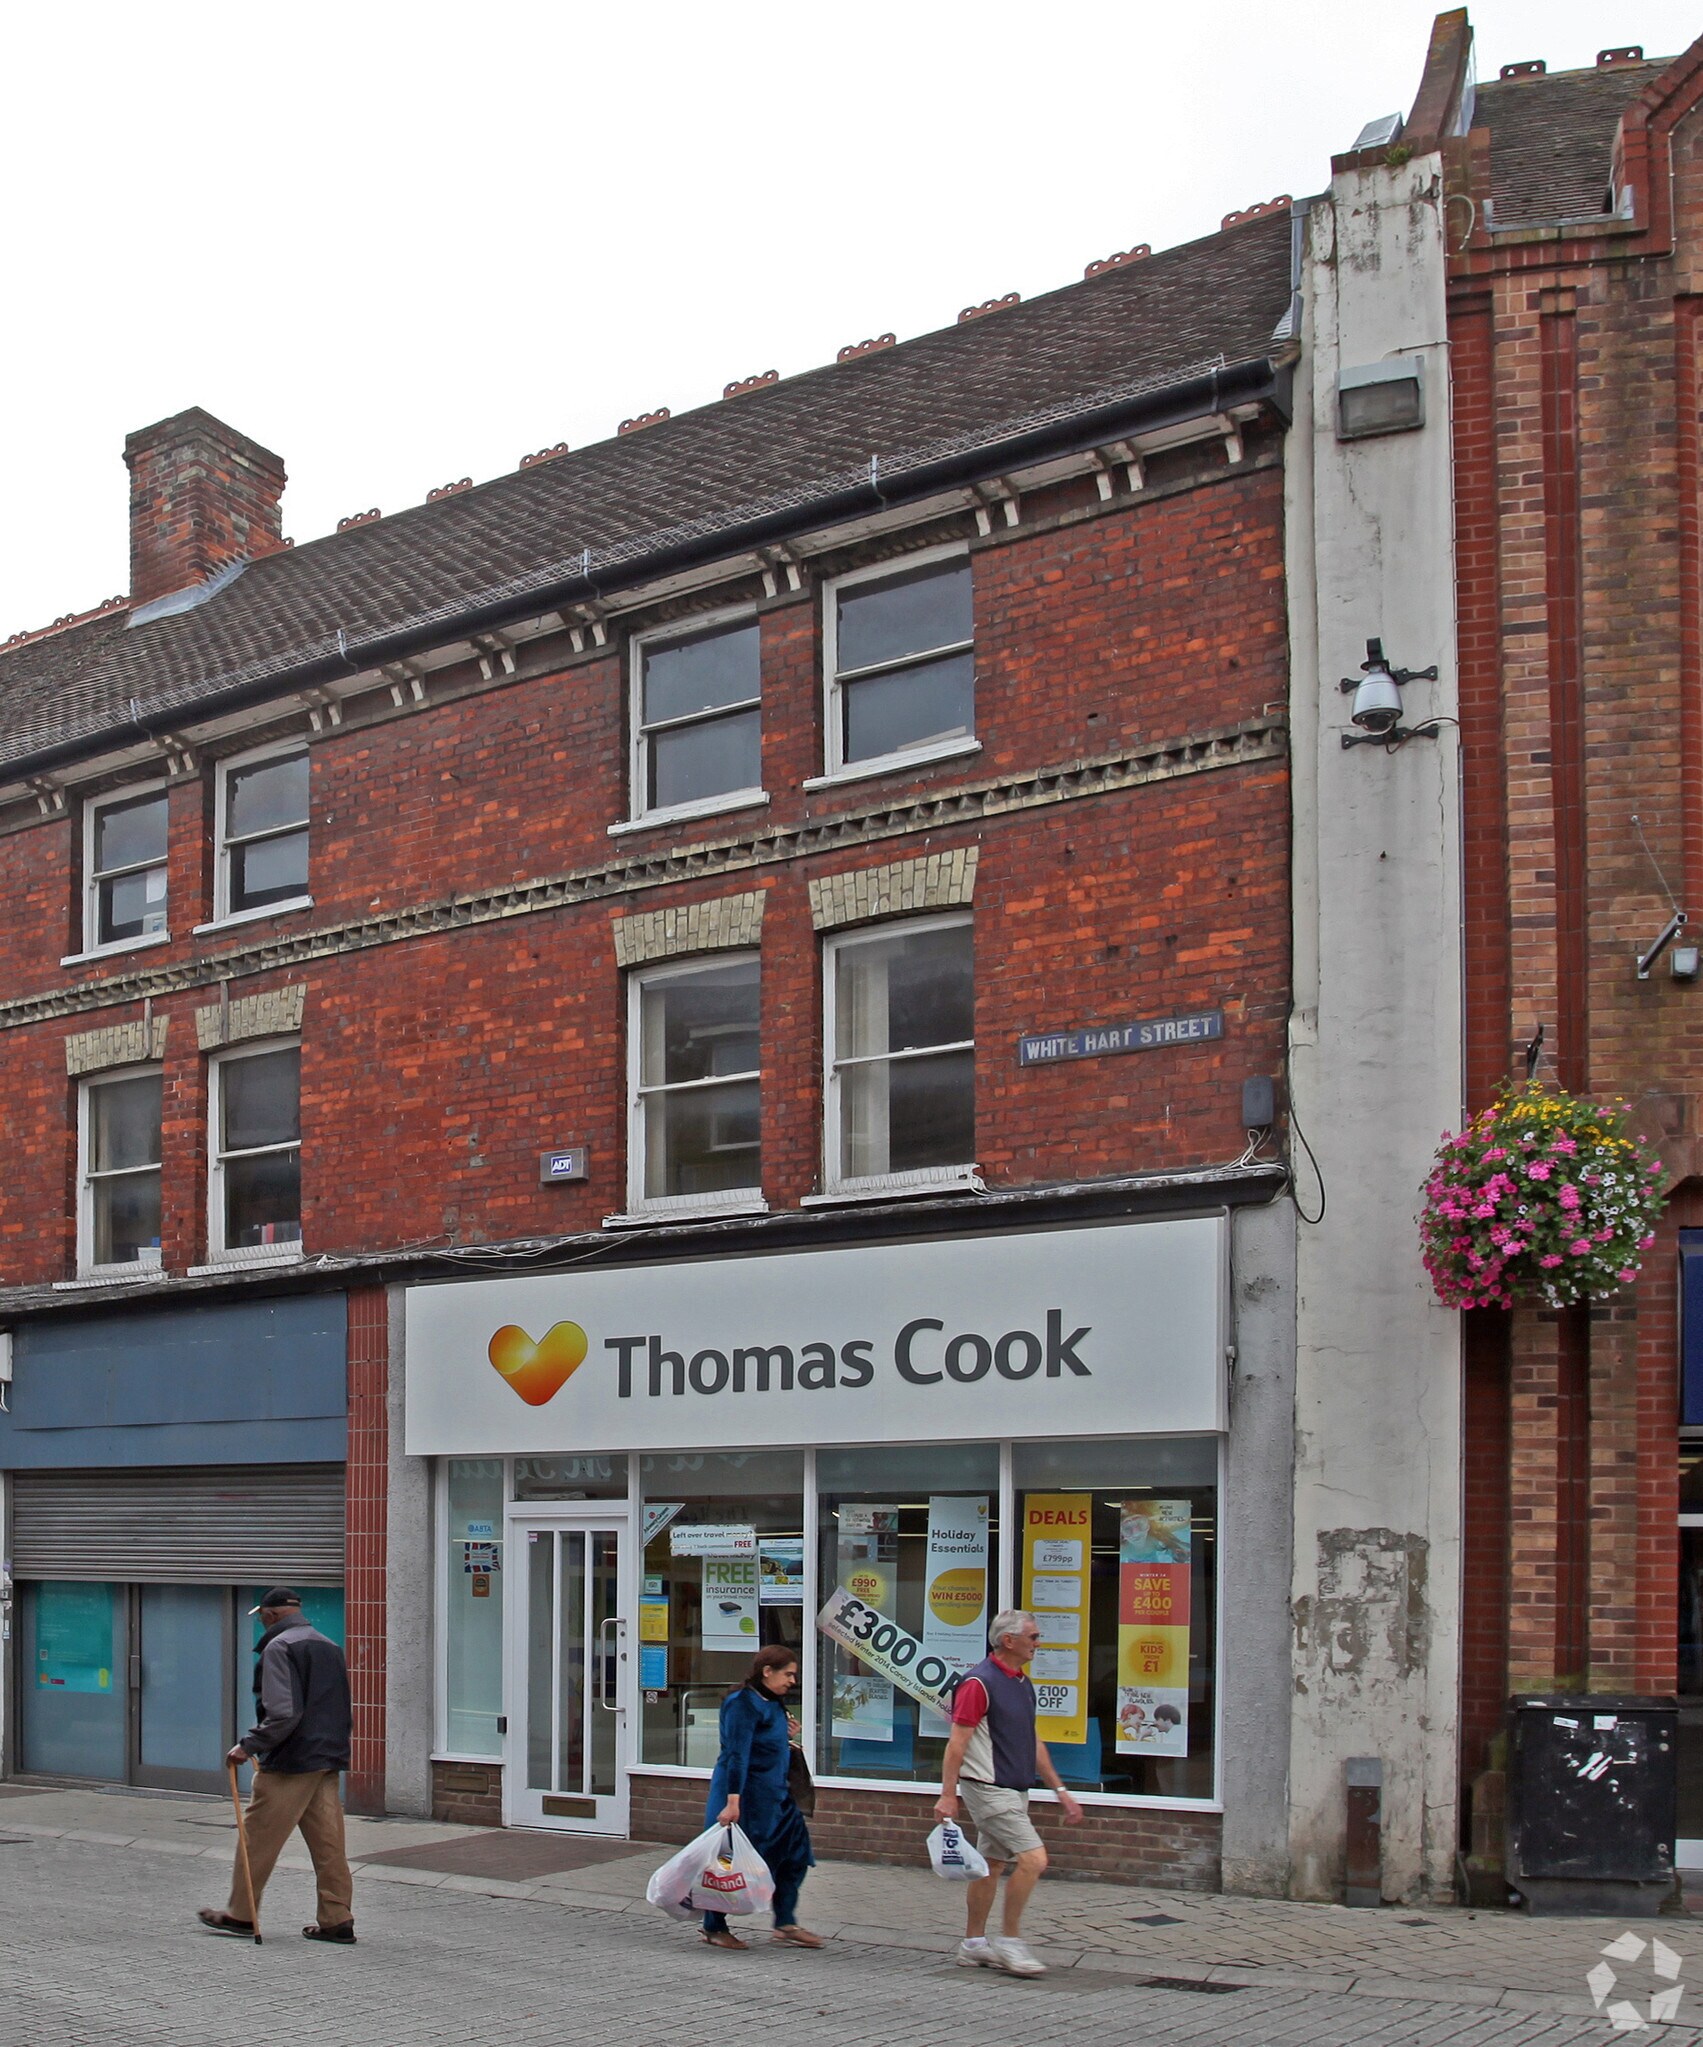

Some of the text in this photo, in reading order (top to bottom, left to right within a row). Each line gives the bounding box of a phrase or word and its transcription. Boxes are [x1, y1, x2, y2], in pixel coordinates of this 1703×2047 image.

[1026, 1017, 1213, 1059] WHITE HART STREET
[551, 1158, 572, 1171] ADT
[603, 1308, 1094, 1400] Thomas Cook
[1029, 1510, 1087, 1525] DEALS
[931, 1529, 976, 1543] Holiday
[734, 1540, 752, 1548] FREE
[931, 1542, 984, 1554] Essentials
[1043, 1555, 1073, 1563] £799pp
[705, 1562, 755, 1584] FREE
[705, 1583, 755, 1595] insurance
[852, 1578, 877, 1588] £990
[1134, 1578, 1171, 1591] SAVE
[931, 1592, 983, 1601] WIN £5000
[1133, 1596, 1172, 1610] £400
[833, 1600, 963, 1698] £300 OF
[1140, 1645, 1164, 1654] KIDS
[828, 1621, 855, 1643] selected
[854, 1640, 875, 1659] Winter
[874, 1654, 891, 1670] 2014
[889, 1666, 914, 1687] Canary
[912, 1683, 937, 1703] Islands
[1143, 1660, 1159, 1673] £1
[1038, 1685, 1069, 1698] £100
[1037, 1697, 1063, 1708] OFF
